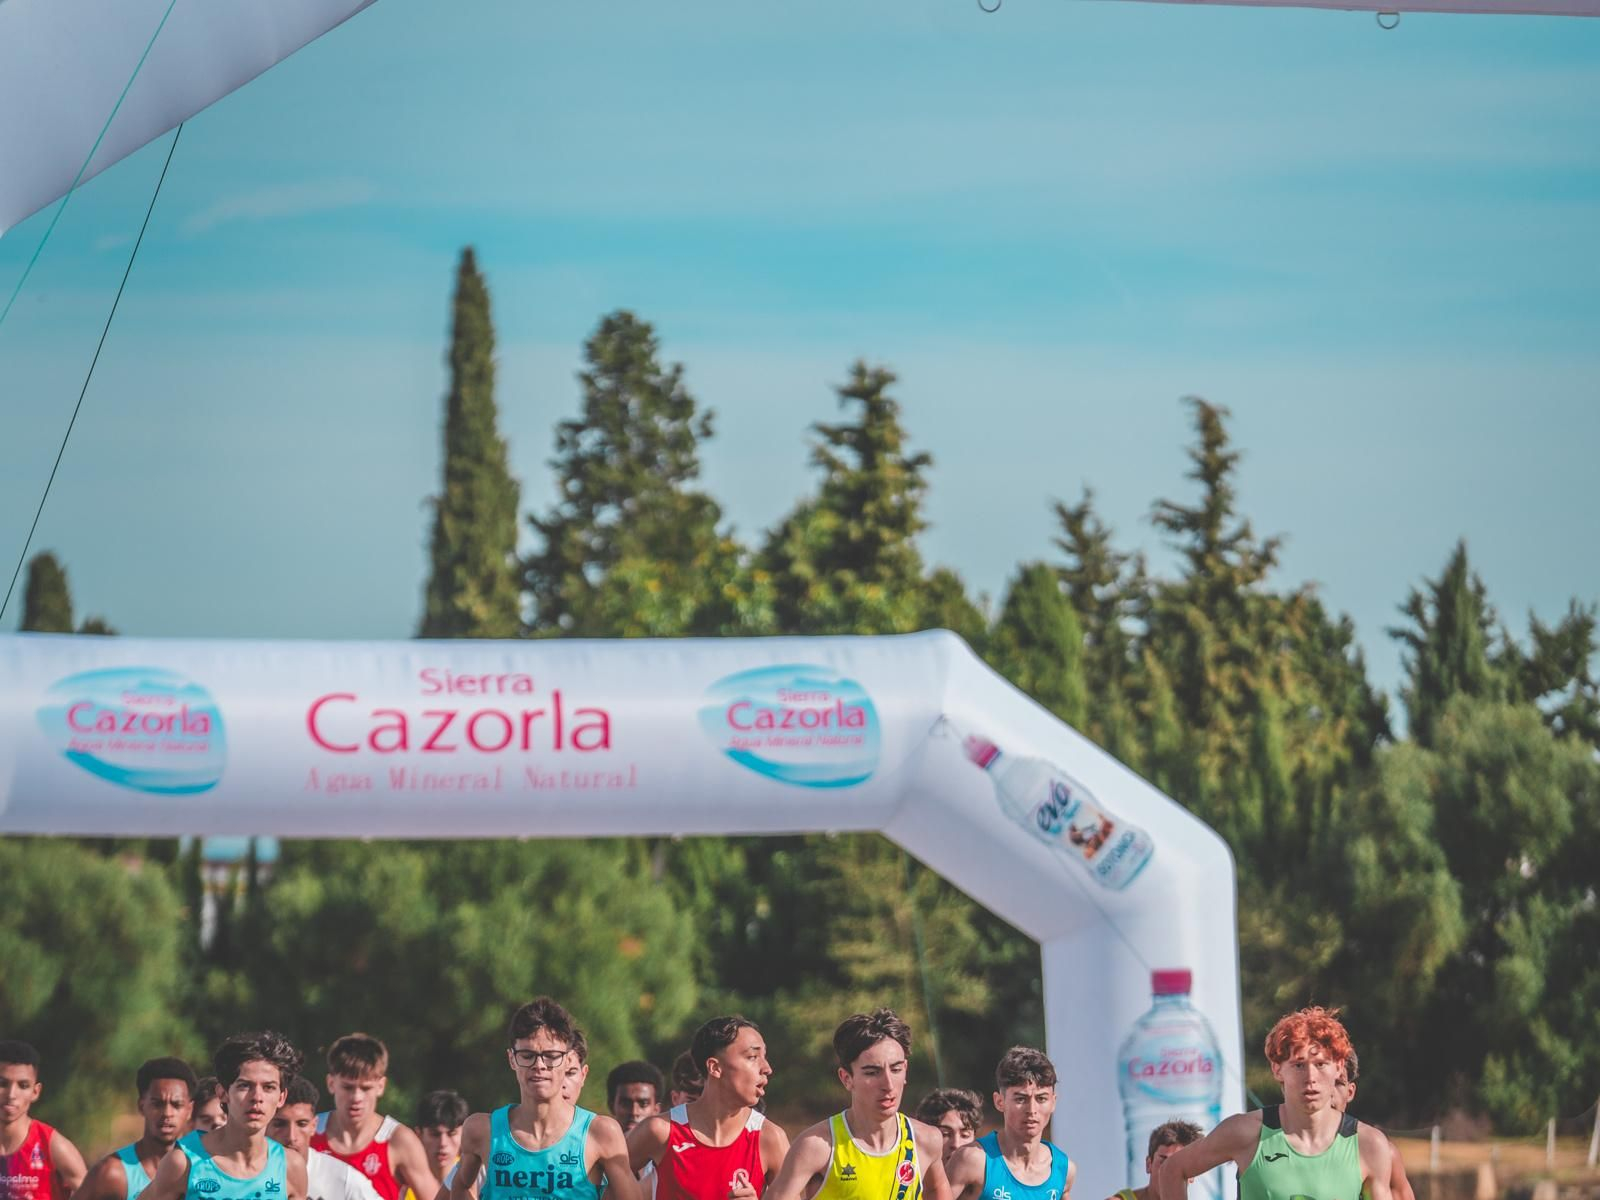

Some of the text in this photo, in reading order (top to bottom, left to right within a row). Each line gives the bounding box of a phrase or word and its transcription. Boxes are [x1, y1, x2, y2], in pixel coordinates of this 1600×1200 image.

[419, 667, 534, 695] Sierra
[67, 702, 211, 735] Cazorla
[305, 688, 613, 753] Cazorla
[727, 698, 866, 731] Cazorla
[304, 764, 638, 793] Agua Mineral Natural
[1128, 1054, 1213, 1078] Cazorla
[494, 1164, 574, 1194] nerja
